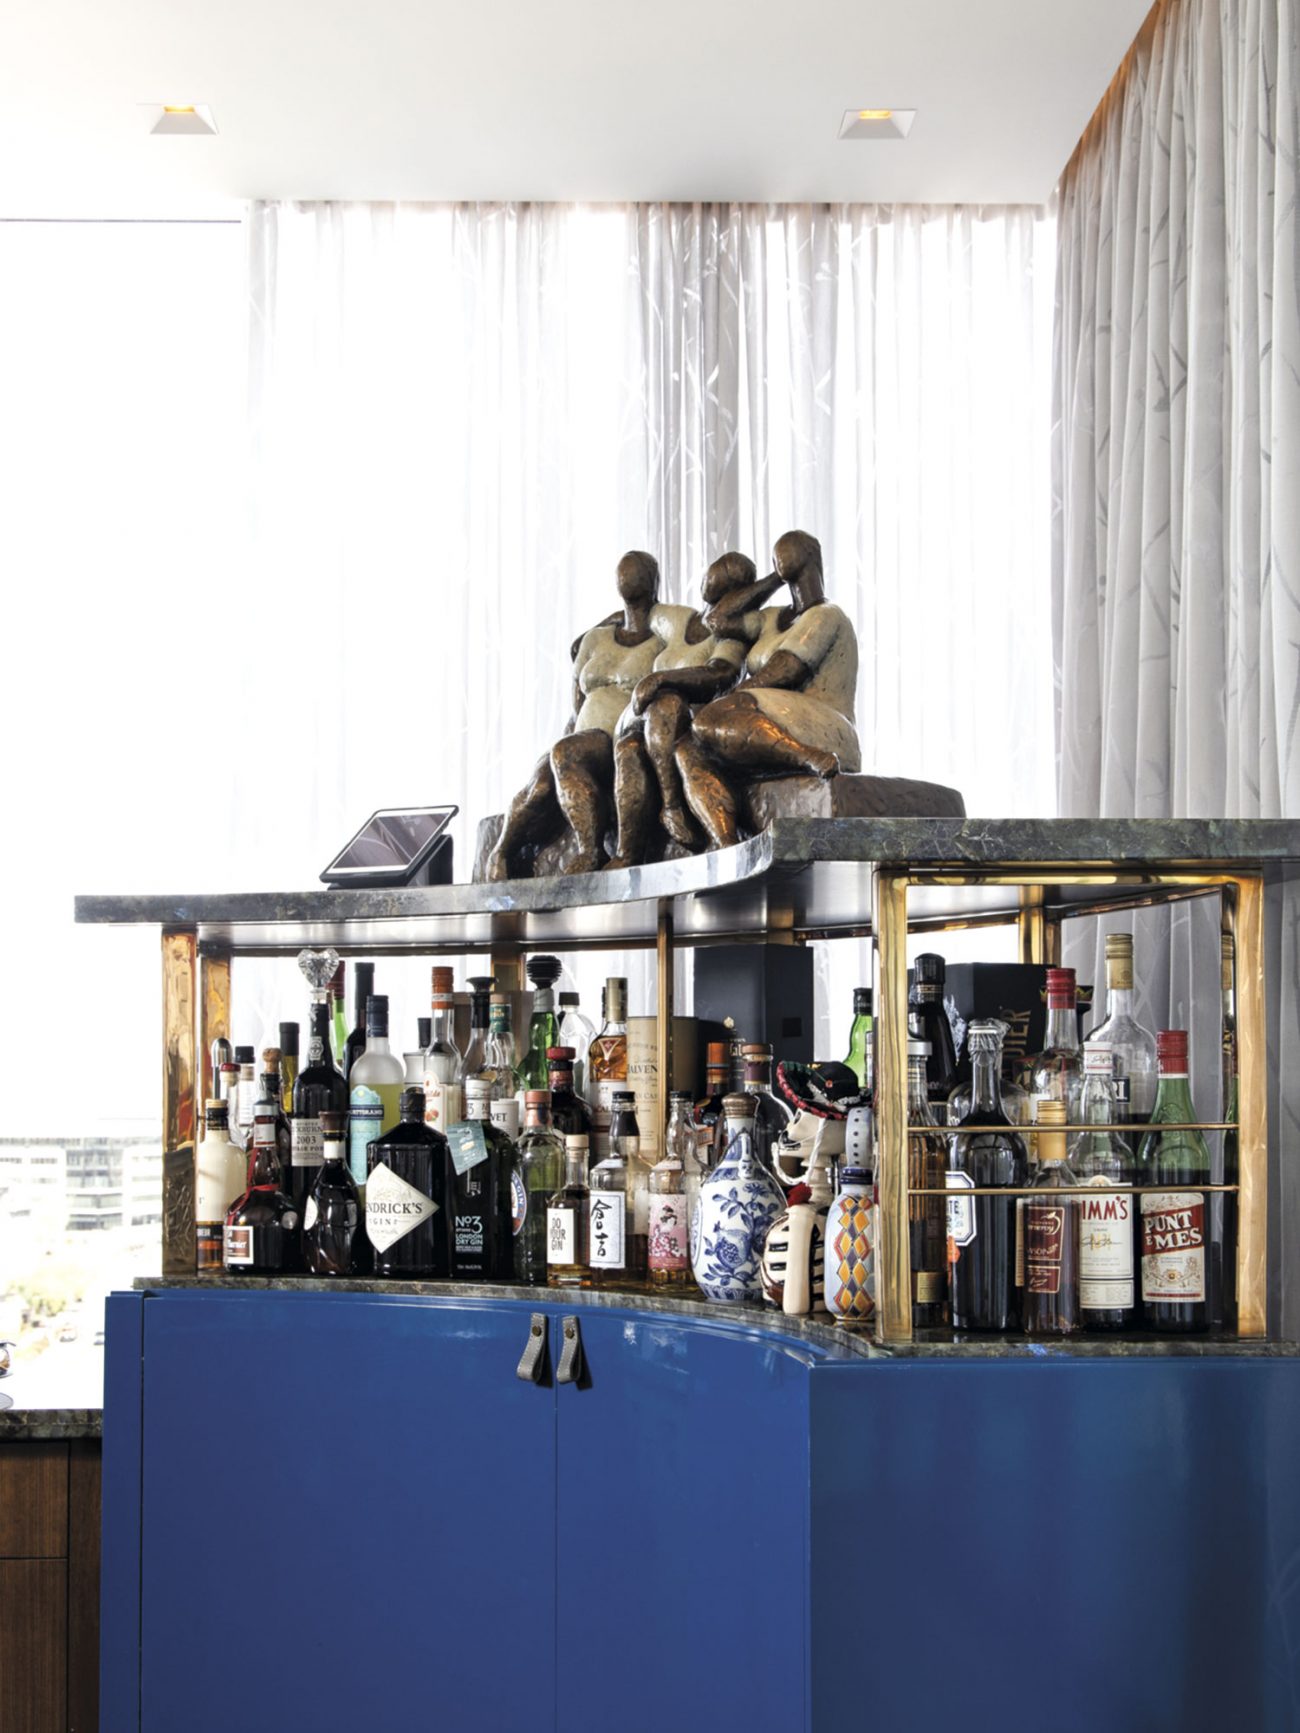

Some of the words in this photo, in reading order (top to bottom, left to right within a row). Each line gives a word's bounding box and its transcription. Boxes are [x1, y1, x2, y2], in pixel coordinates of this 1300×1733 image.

[296, 1135, 317, 1144] 2003
[1081, 1196, 1129, 1220] IMM'S
[1143, 1210, 1193, 1234] PUNT
[1145, 1235, 1153, 1246] E
[1153, 1227, 1203, 1250] MES
